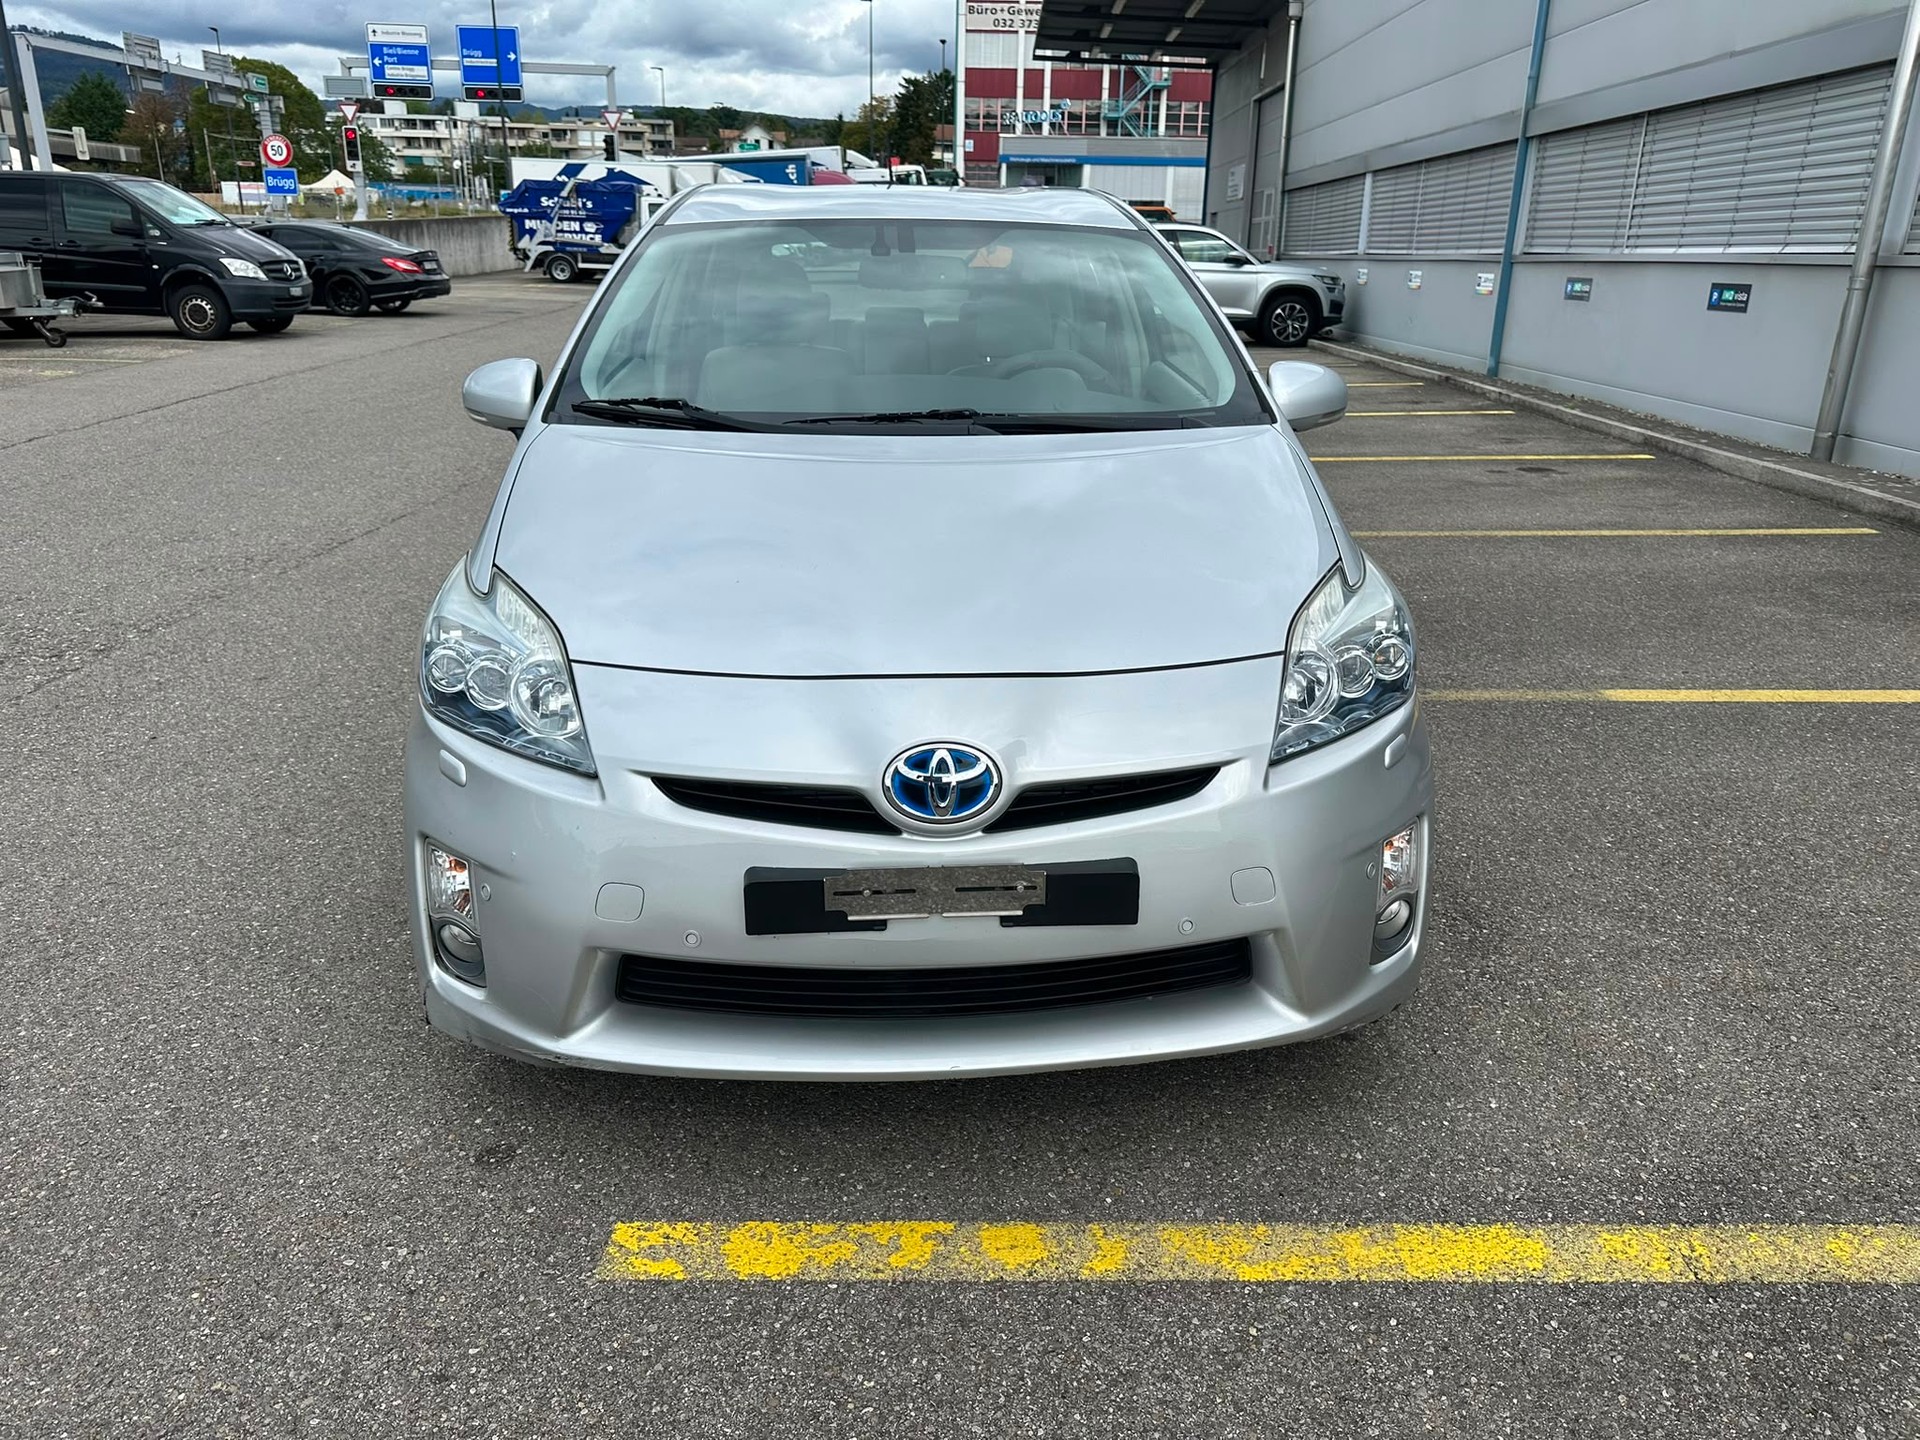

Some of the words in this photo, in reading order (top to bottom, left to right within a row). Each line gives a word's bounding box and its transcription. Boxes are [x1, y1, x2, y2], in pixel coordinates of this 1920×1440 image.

[993, 18, 1015, 28] 032
[462, 48, 482, 57] Brügg
[270, 145, 284, 157] 50
[267, 176, 295, 190] Brügg
